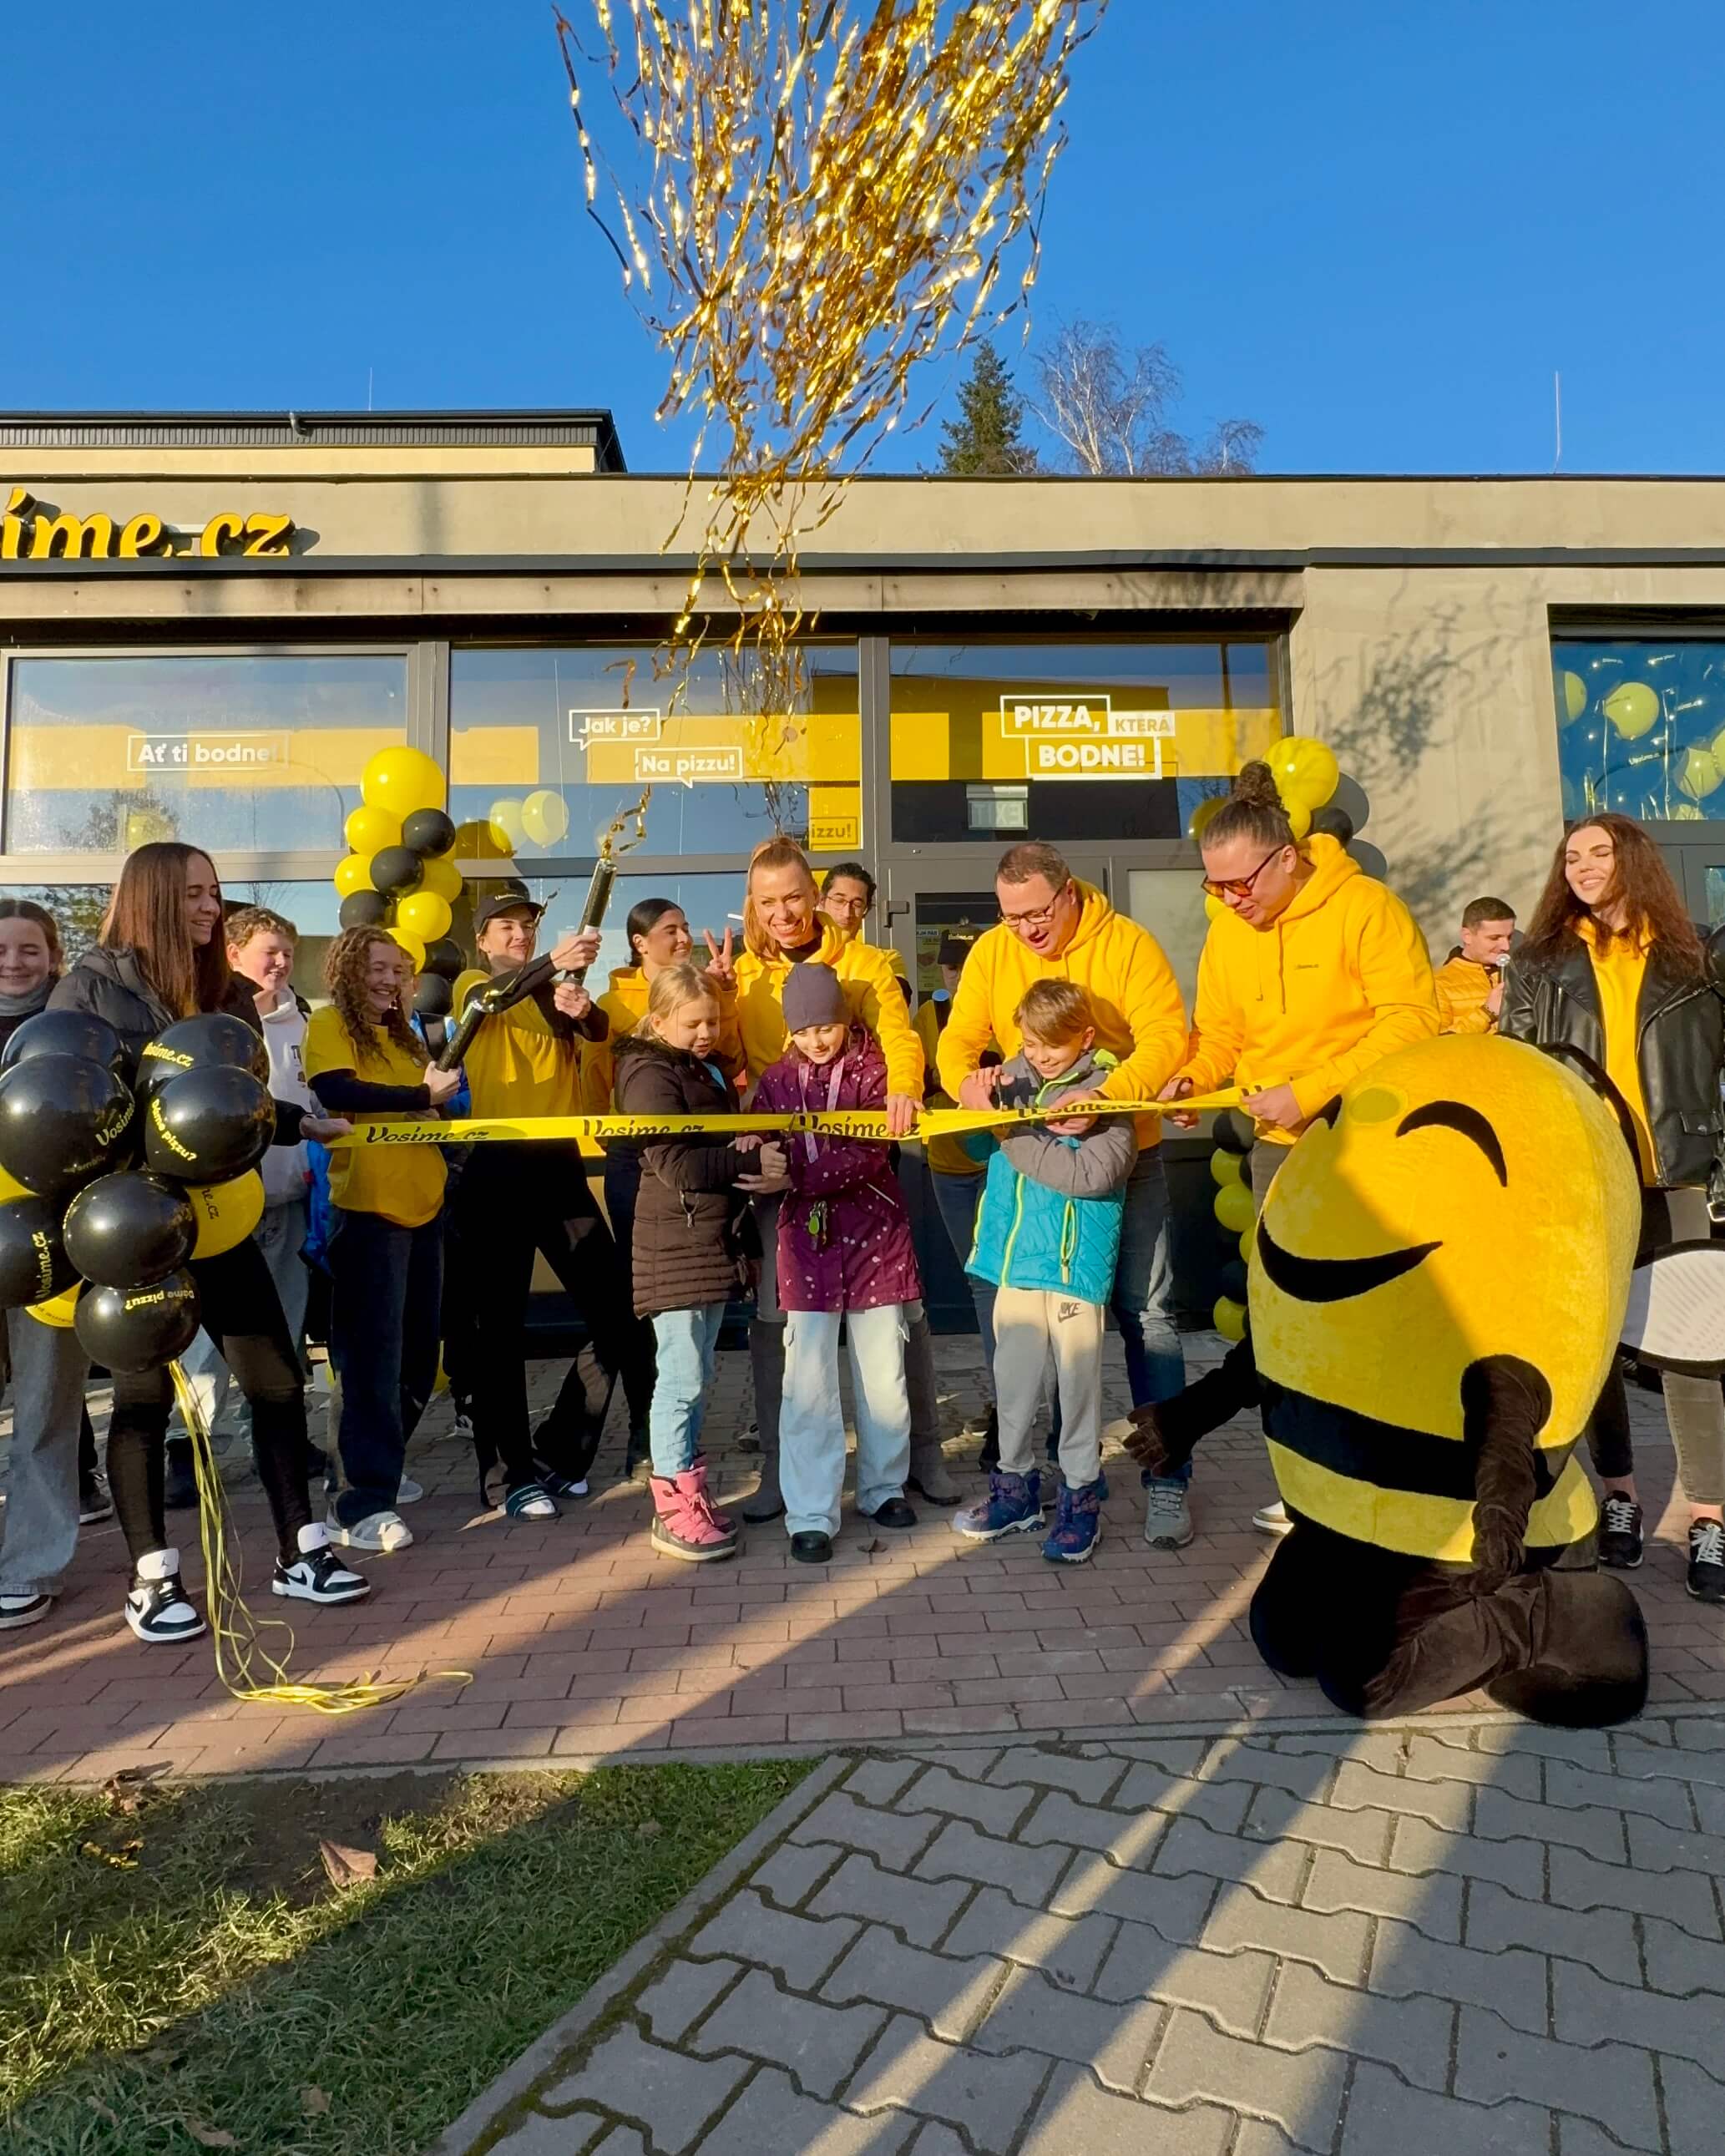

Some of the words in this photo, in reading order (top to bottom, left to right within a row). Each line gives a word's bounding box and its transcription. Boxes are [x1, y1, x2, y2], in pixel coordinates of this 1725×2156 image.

[578, 716, 616, 735] Jak
[620, 716, 651, 737] je?
[1014, 706, 1101, 732] PIZZA,
[1115, 716, 1171, 732] KTERÁ
[138, 742, 167, 762] Ať
[172, 743, 188, 762] ti
[1038, 744, 1146, 767] BODNE!
[642, 755, 670, 772] Na
[676, 754, 736, 776] pizzu!
[583, 1119, 705, 1137] Vosímecz
[798, 1115, 921, 1138] Vosímez
[161, 1130, 198, 1162] pizzu?
[125, 1290, 165, 1310] pizzu?
[1060, 1302, 1082, 1316] NIKE
